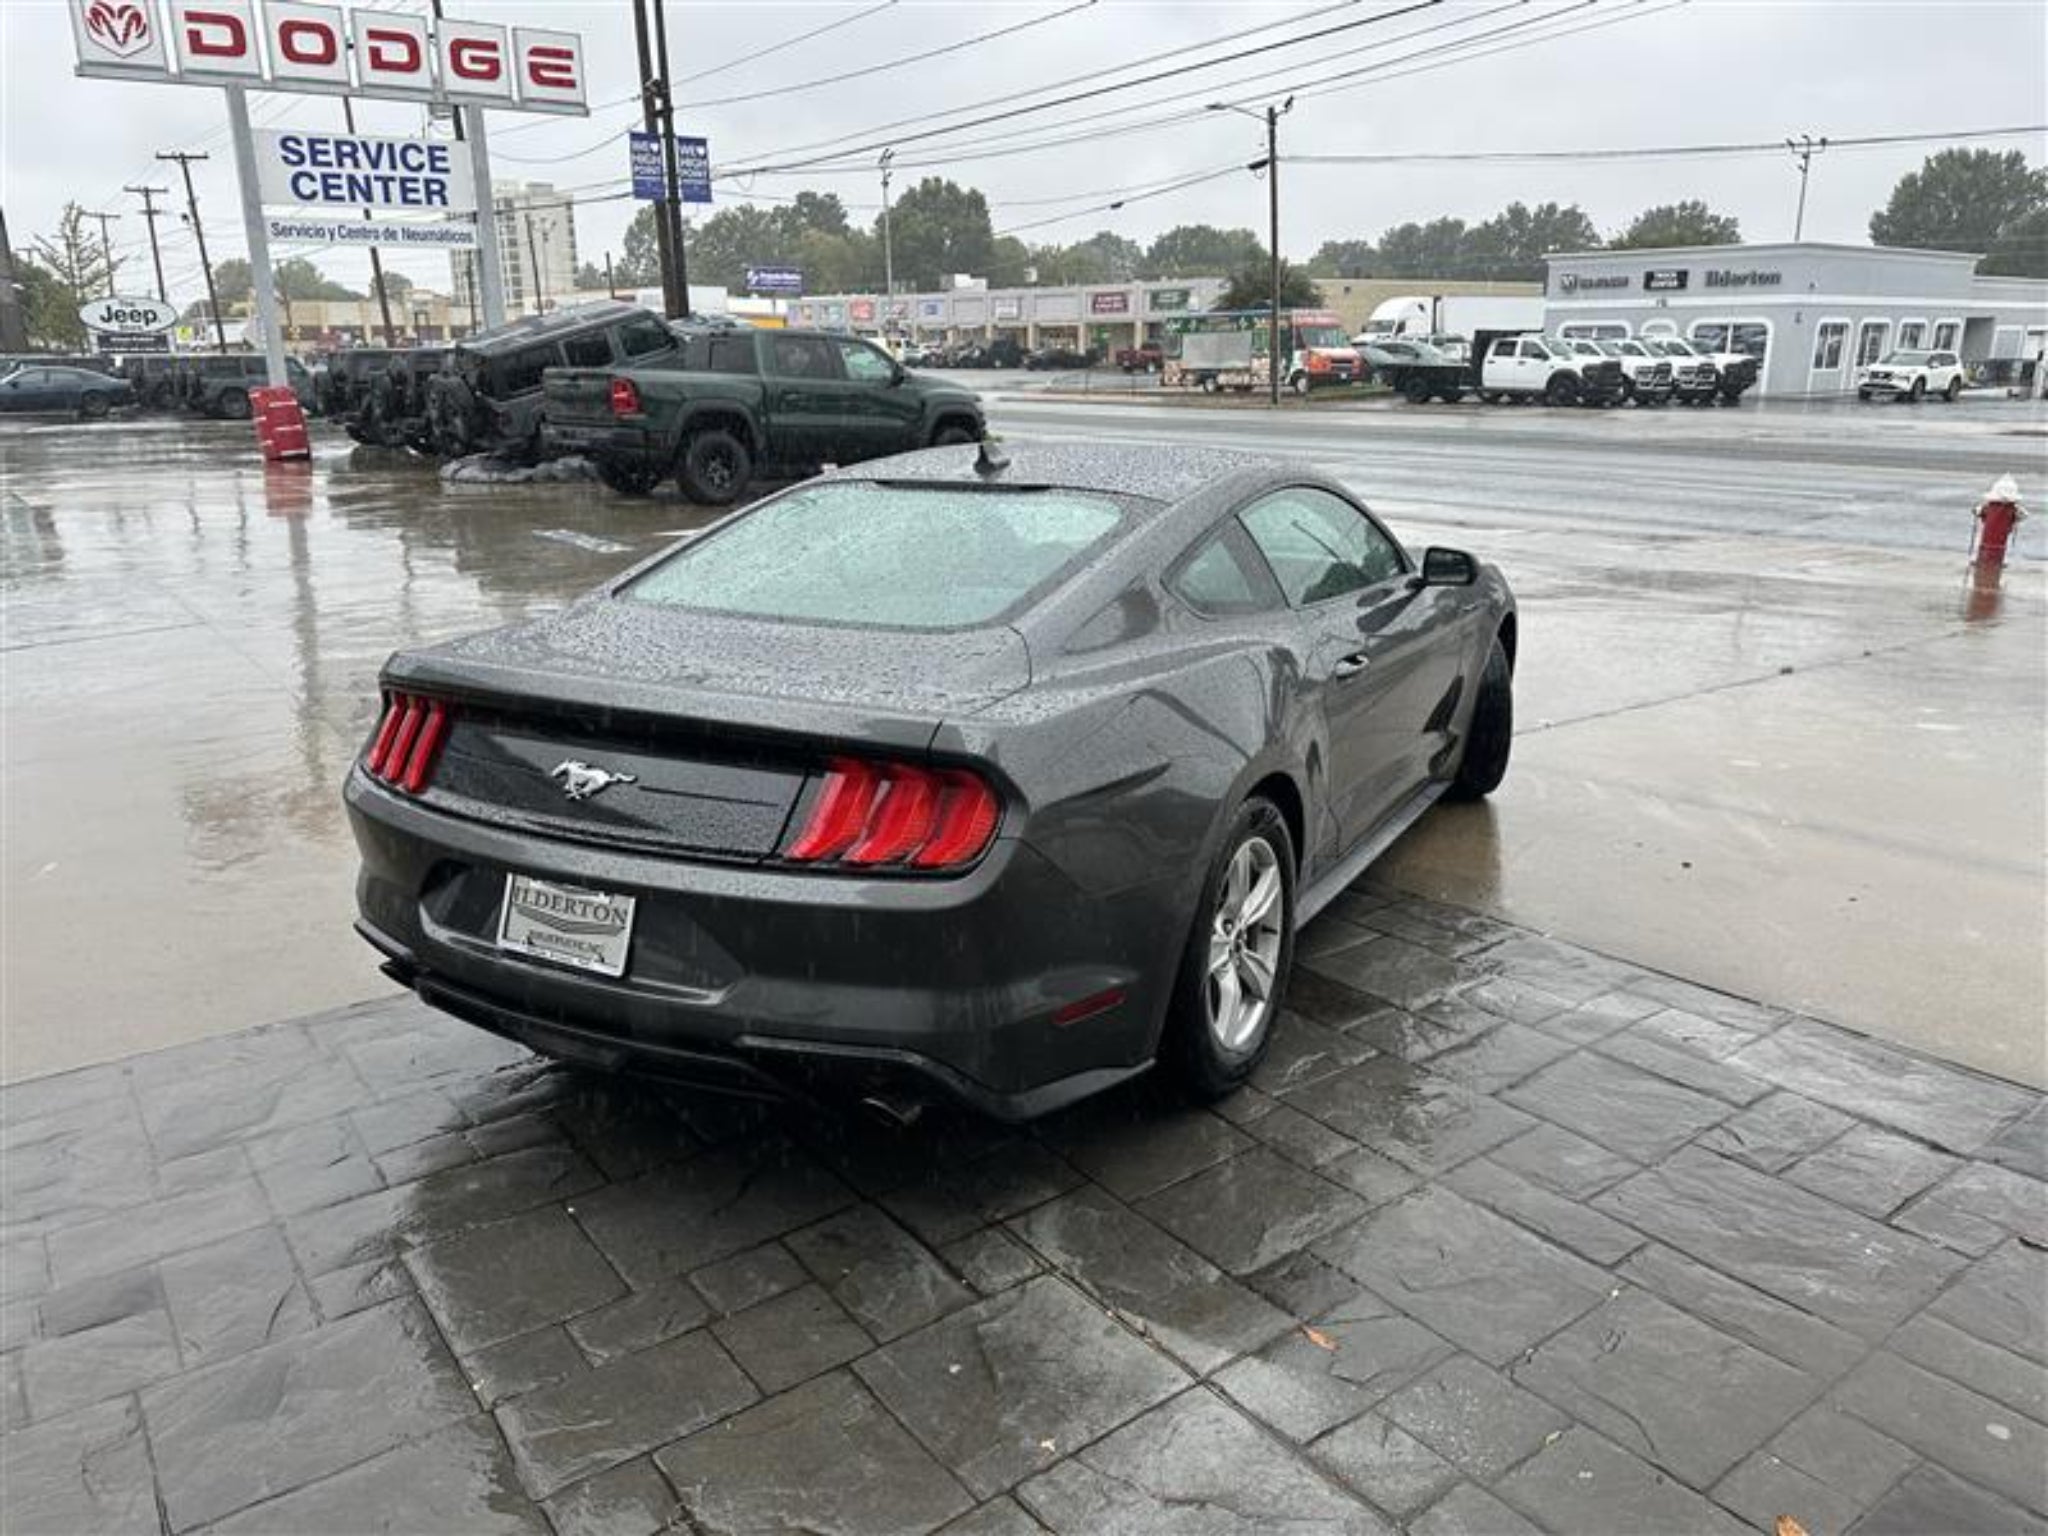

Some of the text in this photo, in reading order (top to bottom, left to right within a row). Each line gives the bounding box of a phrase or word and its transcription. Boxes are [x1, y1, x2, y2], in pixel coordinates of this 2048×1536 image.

[184, 11, 577, 89] DODGE
[279, 135, 451, 174] SERVICE
[290, 171, 449, 206] CENTER
[271, 222, 474, 244] Servicio y Centro de Neumáticos
[99, 304, 158, 327] Jeep
[513, 884, 629, 926] ILDERTON
